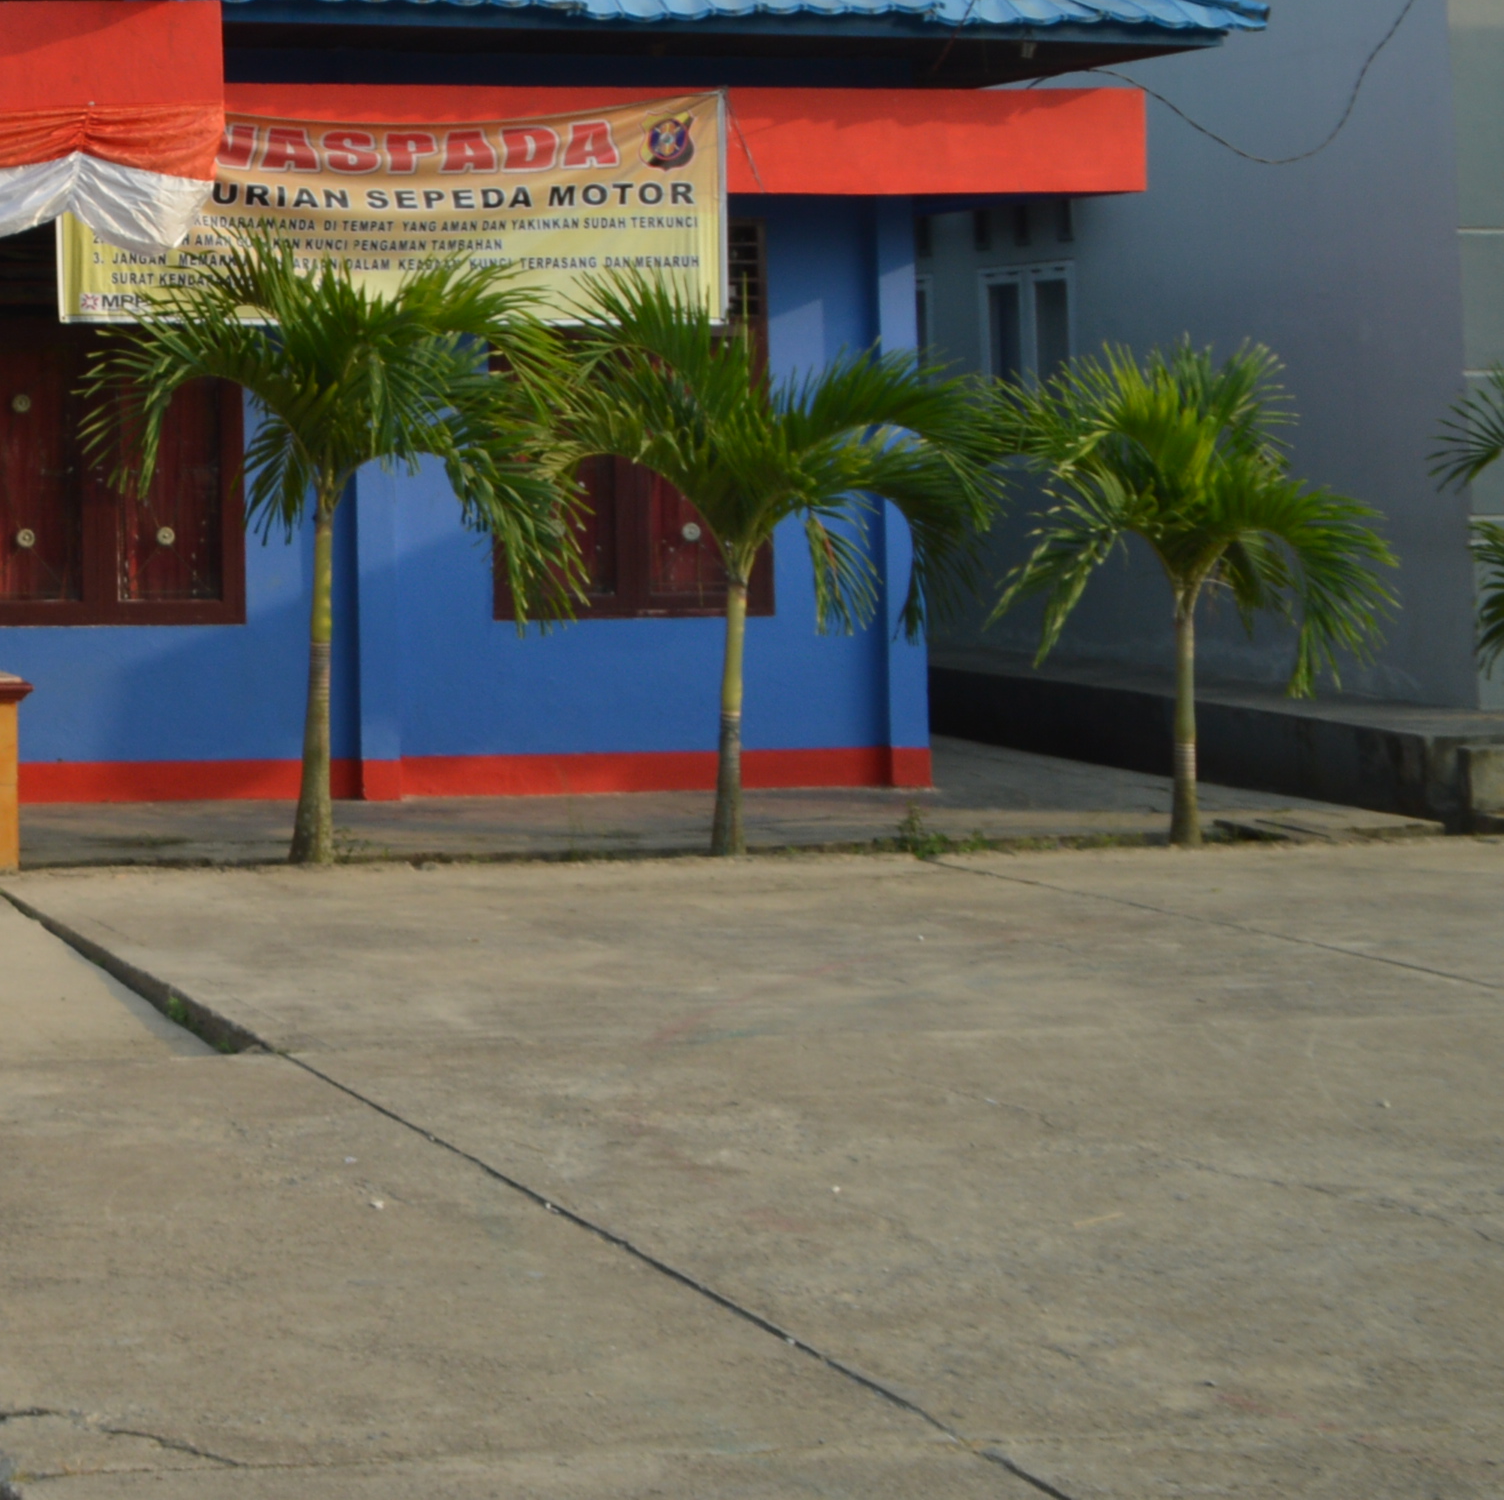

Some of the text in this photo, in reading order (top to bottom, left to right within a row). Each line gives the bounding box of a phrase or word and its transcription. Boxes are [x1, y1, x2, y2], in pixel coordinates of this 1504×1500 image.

[212, 182, 694, 210] URIAN SEPEDA MOTOR
[279, 219, 315, 231] ANDA
[324, 220, 337, 231] DI
[342, 220, 394, 232] TEMPAT
[402, 221, 437, 232] YANG
[441, 220, 478, 232] AMAN
[482, 220, 507, 231] DAN
[512, 218, 579, 230] YAKINKAN
[584, 217, 626, 229] SUDAH
[631, 216, 698, 228] TERKUNCI
[305, 238, 348, 250] KUNCI
[353, 239, 427, 251] PENGAMAN
[432, 239, 502, 251] TAMBAHAN
[112, 252, 166, 265] JANGAN
[521, 257, 596, 269] TERPASANG
[605, 256, 630, 268] DAN
[635, 256, 699, 268] MENARUH
[112, 272, 154, 284] SURAT
